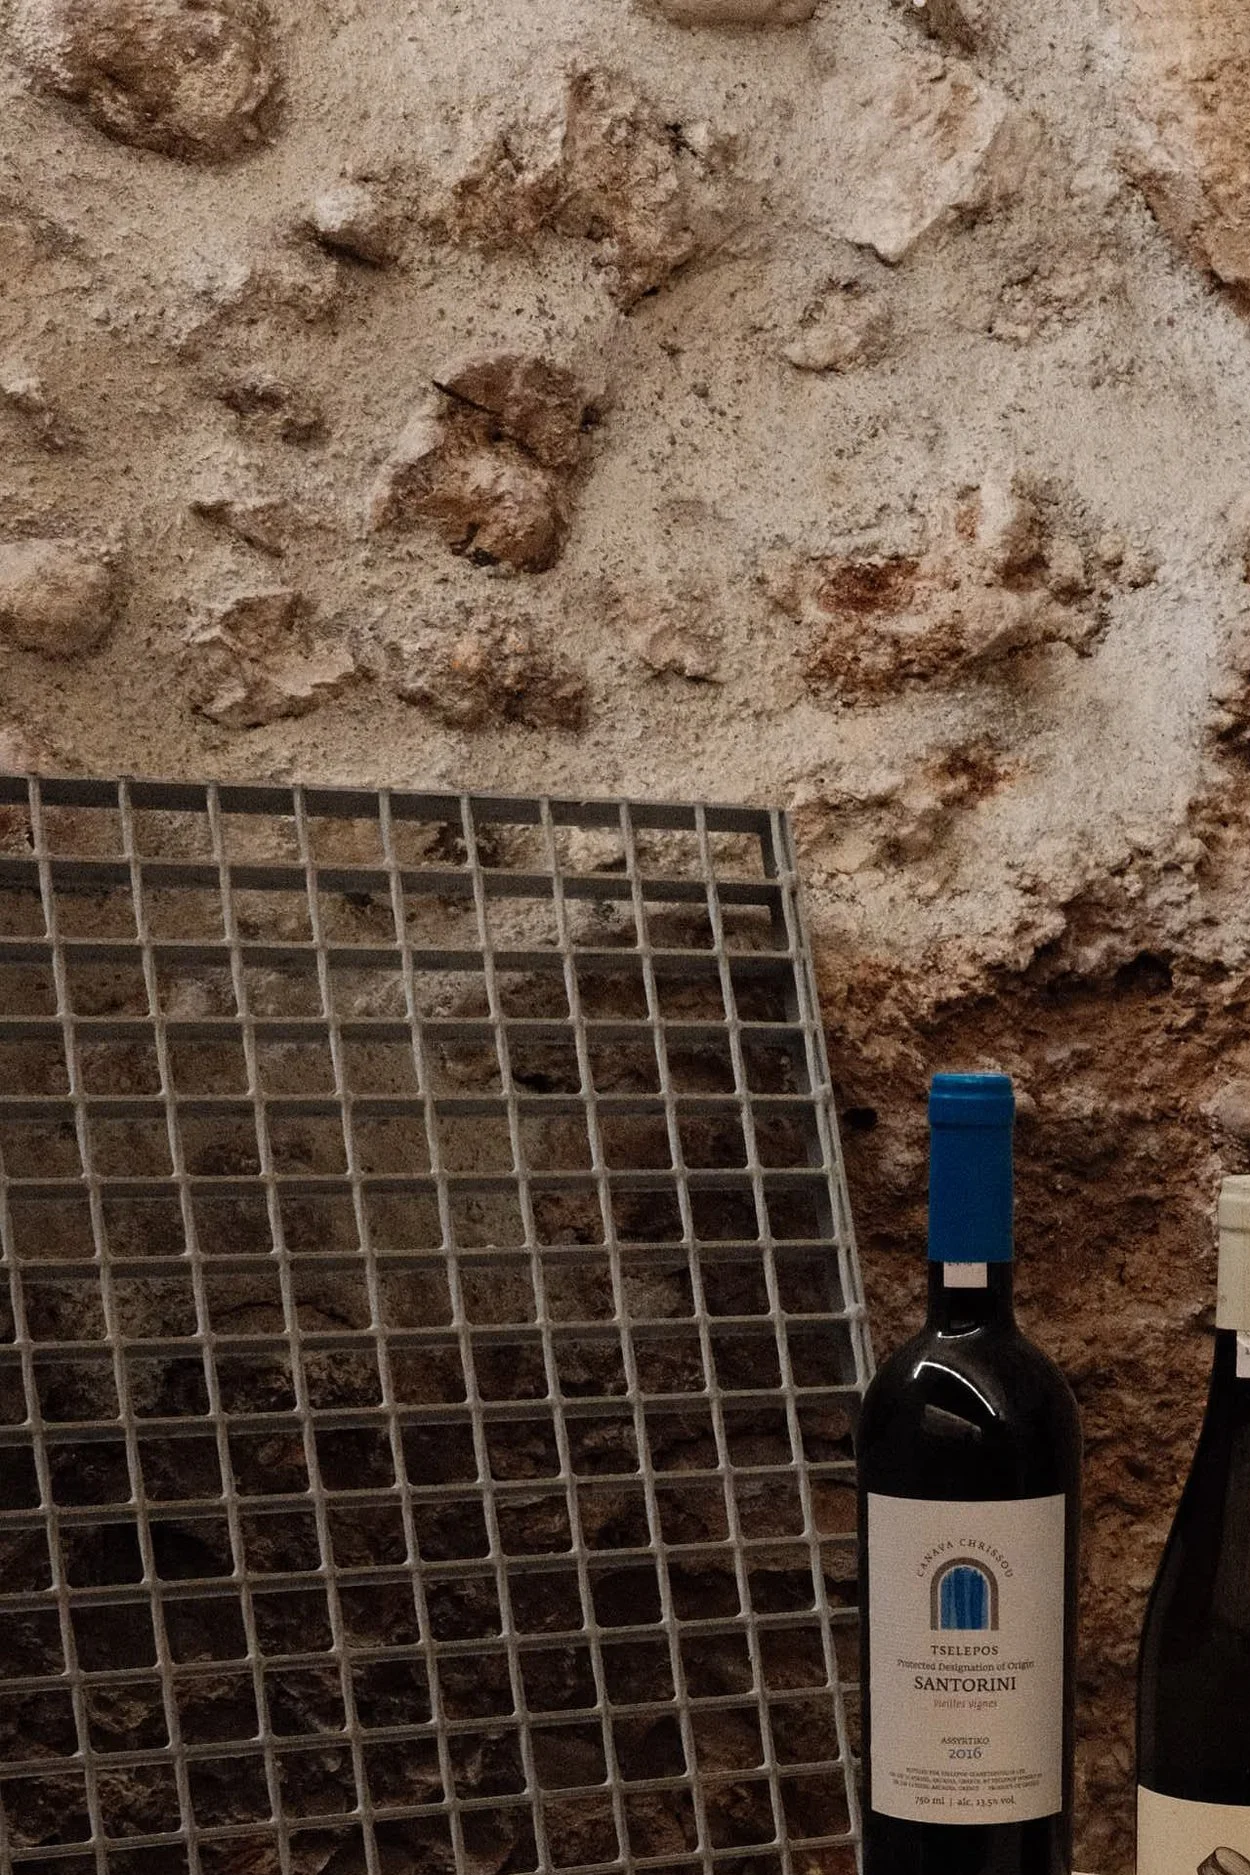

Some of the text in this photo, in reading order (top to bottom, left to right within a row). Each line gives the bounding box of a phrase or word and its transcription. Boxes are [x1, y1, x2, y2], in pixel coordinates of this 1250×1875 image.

[917, 1538, 1014, 1578] CANAVA CHRISSOU
[931, 1645, 999, 1656] TSELEPOS
[897, 1658, 1035, 1674] Protected Designation of Origin
[914, 1676, 1017, 1692] SANTORINI
[941, 1737, 990, 1746] ASSYRTIKO
[949, 1748, 982, 1760] 2016
[914, 1796, 930, 1805] 750
